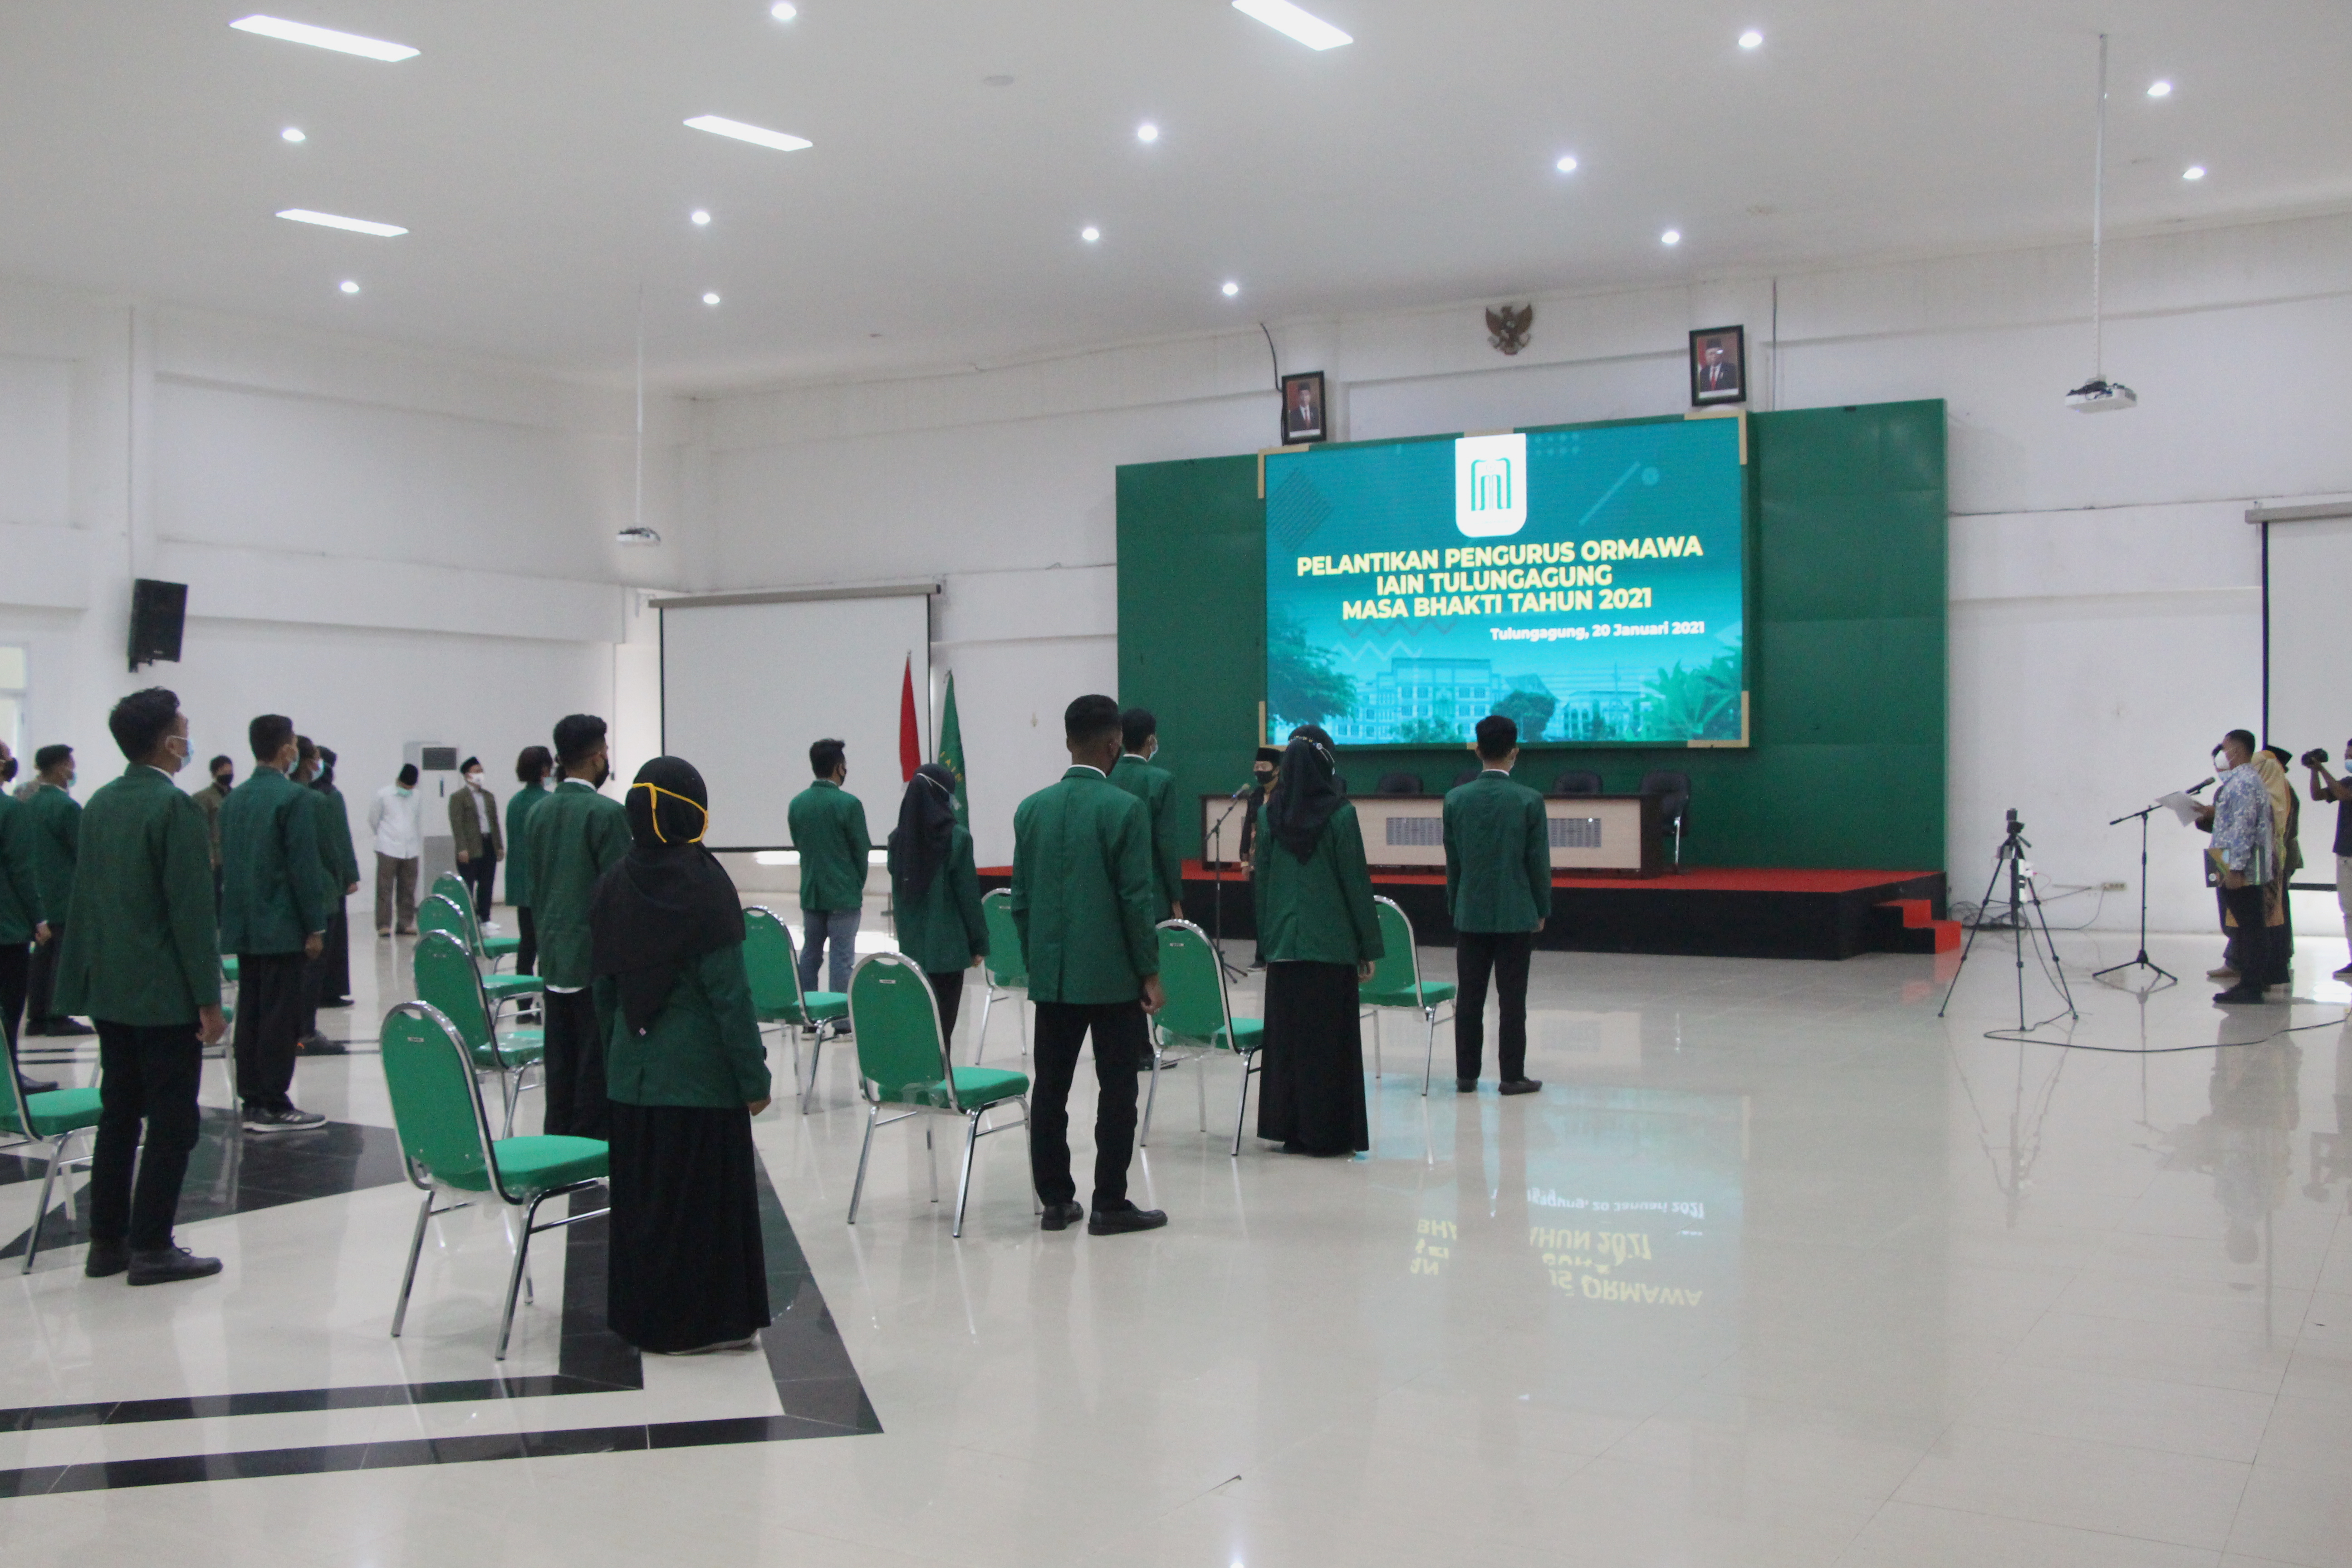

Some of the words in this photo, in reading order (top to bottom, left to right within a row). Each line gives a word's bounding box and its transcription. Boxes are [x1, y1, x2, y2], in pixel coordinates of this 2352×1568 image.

[1298, 549, 1438, 576] PELANTIKAN
[1445, 542, 1575, 568] PENGURUS
[1581, 535, 1703, 561] ORMAWA
[1377, 573, 1424, 595] IAIN
[1429, 564, 1612, 593] TULUNGAGUNG
[1343, 598, 1409, 620] MASA
[1414, 594, 1502, 617] BHAKTI
[1508, 590, 1592, 612] TAHUN
[1599, 588, 1651, 609] 2021
[1490, 627, 1590, 642] Tulungagung,
[1592, 624, 1611, 637] 20
[1613, 621, 1669, 636] Januari
[1672, 621, 1705, 634] 2021
